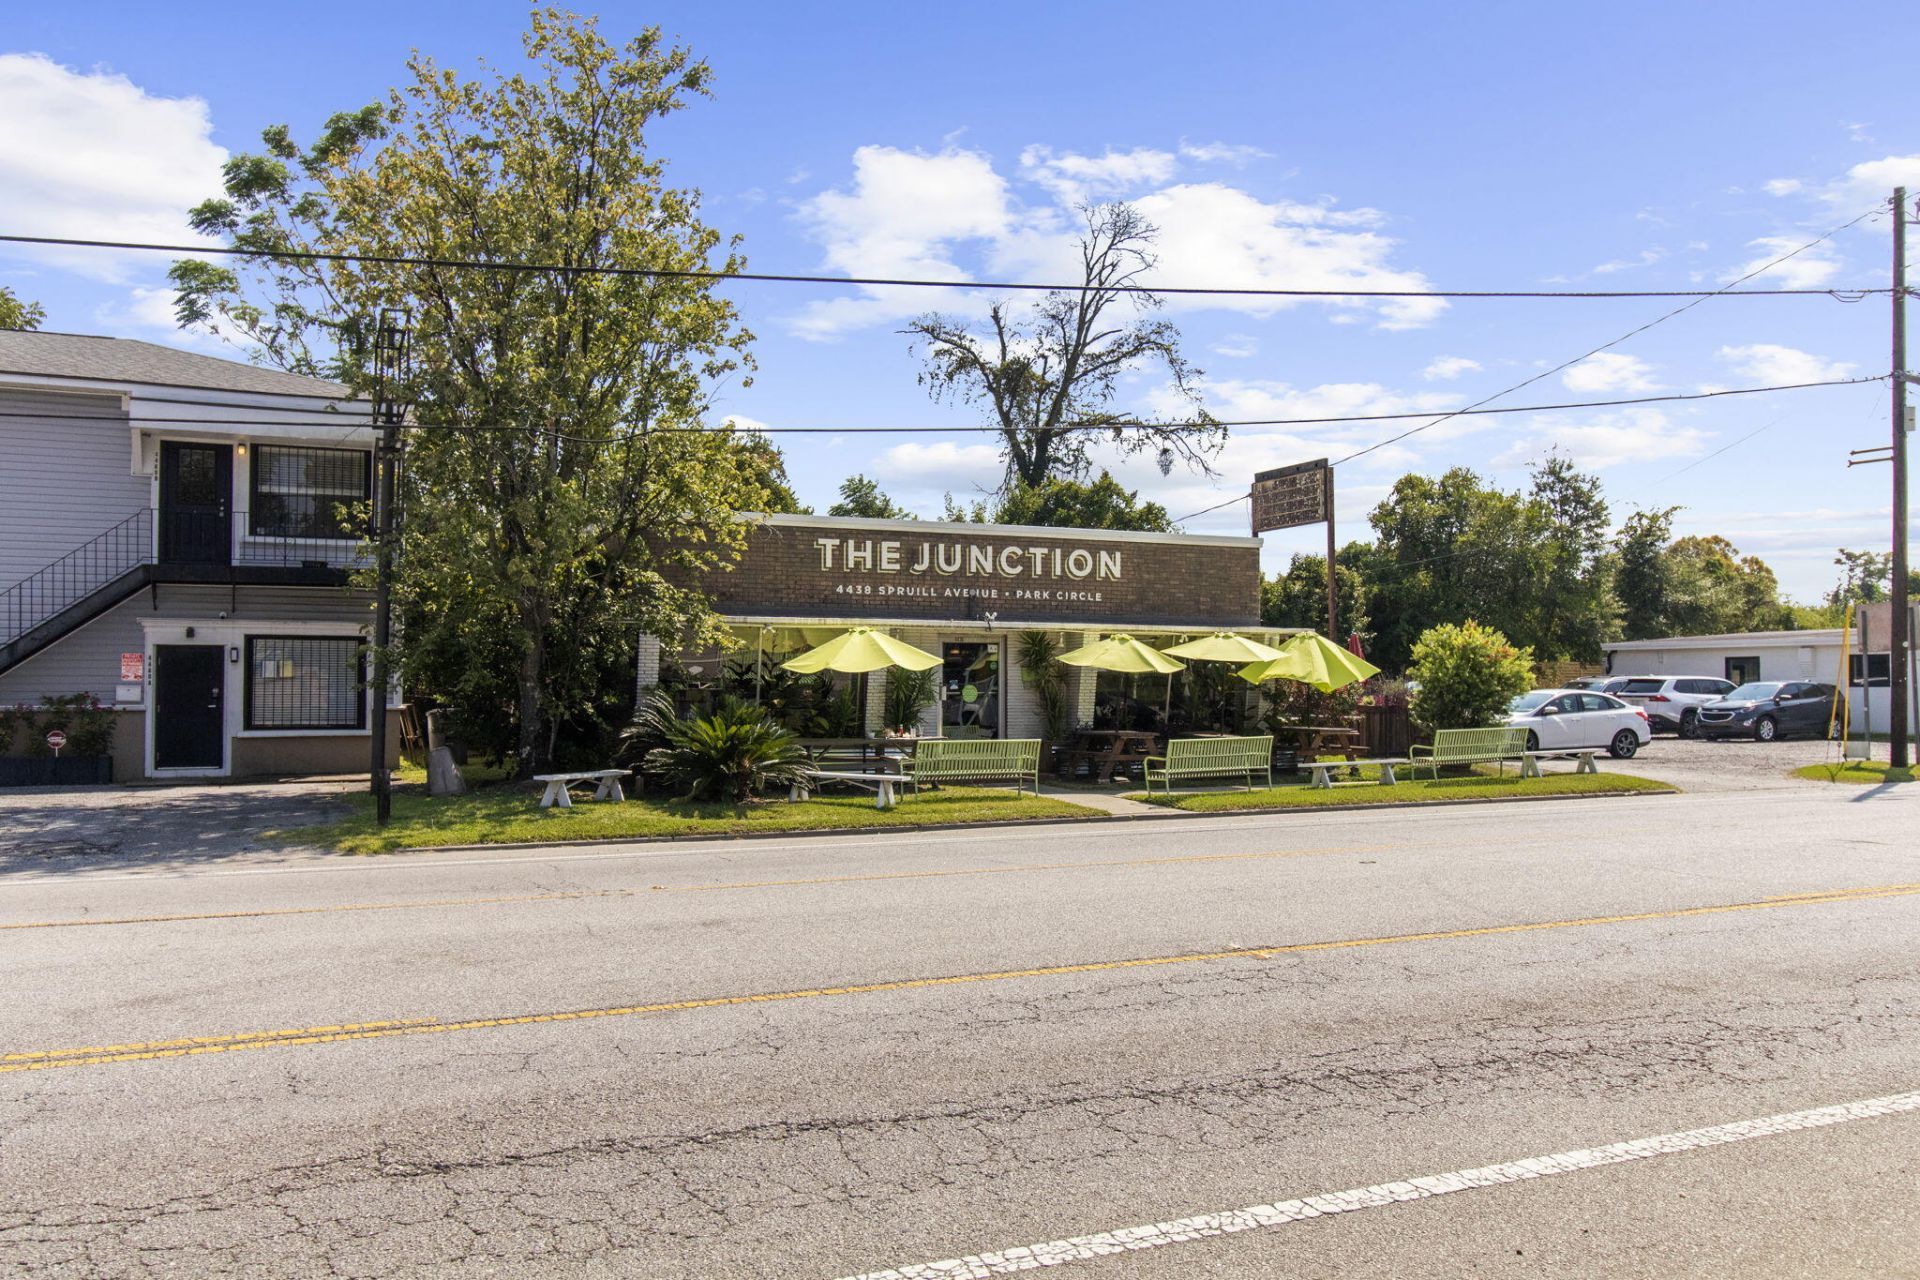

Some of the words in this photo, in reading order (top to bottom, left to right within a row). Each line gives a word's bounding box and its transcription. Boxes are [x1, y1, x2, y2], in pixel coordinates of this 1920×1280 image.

[815, 538, 900, 573] THE
[910, 542, 1121, 580] JUNCTION
[836, 585, 871, 595] 4438
[879, 586, 937, 597] SPRUILL
[1016, 590, 1050, 600] PARK
[1057, 591, 1102, 602] CIRCLE
